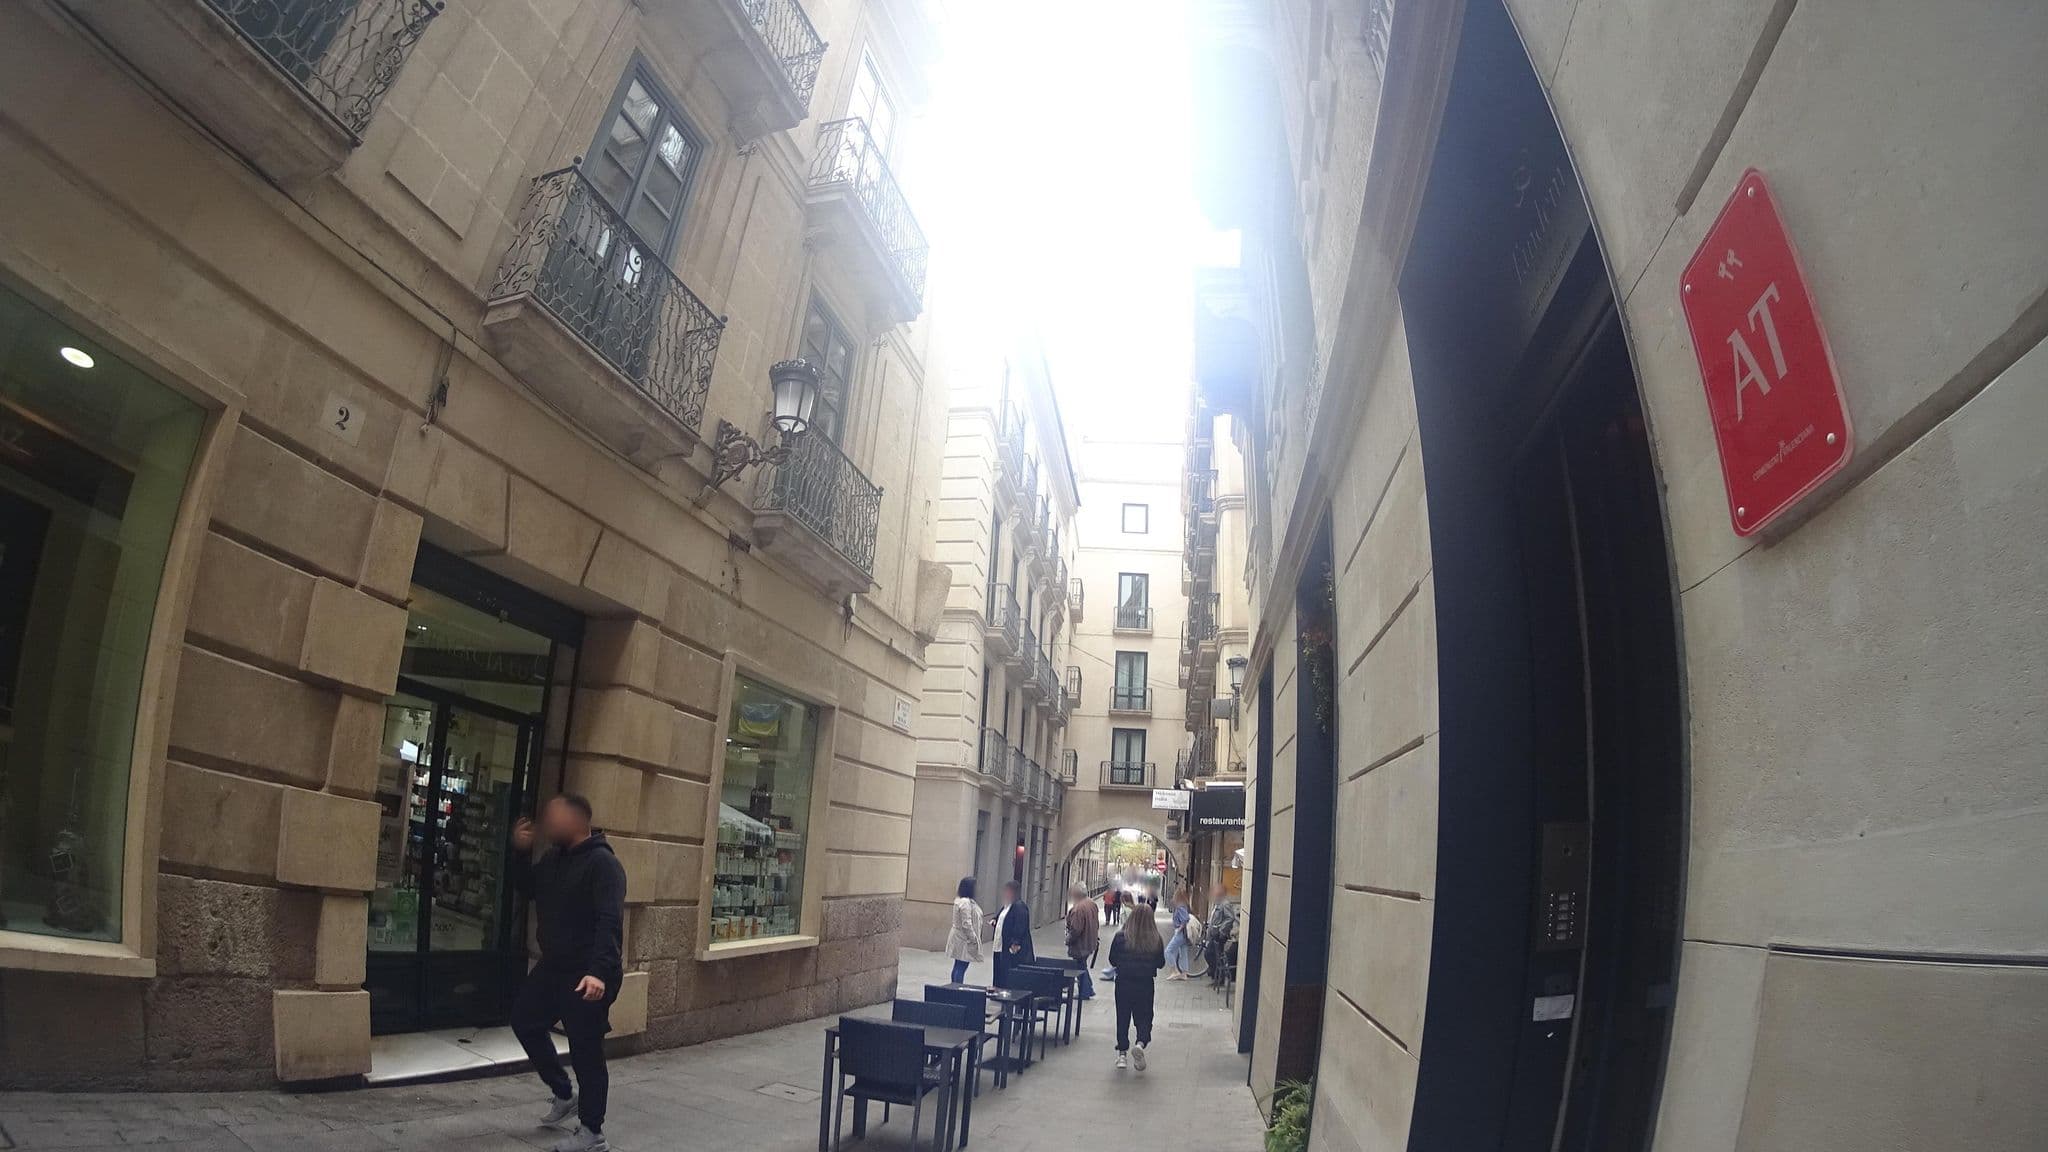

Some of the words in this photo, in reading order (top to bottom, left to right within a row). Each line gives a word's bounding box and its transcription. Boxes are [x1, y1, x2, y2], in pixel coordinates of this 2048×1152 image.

[1726, 281, 1788, 423] AT
[335, 406, 350, 431] 2
[1199, 817, 1246, 825] restaurante
